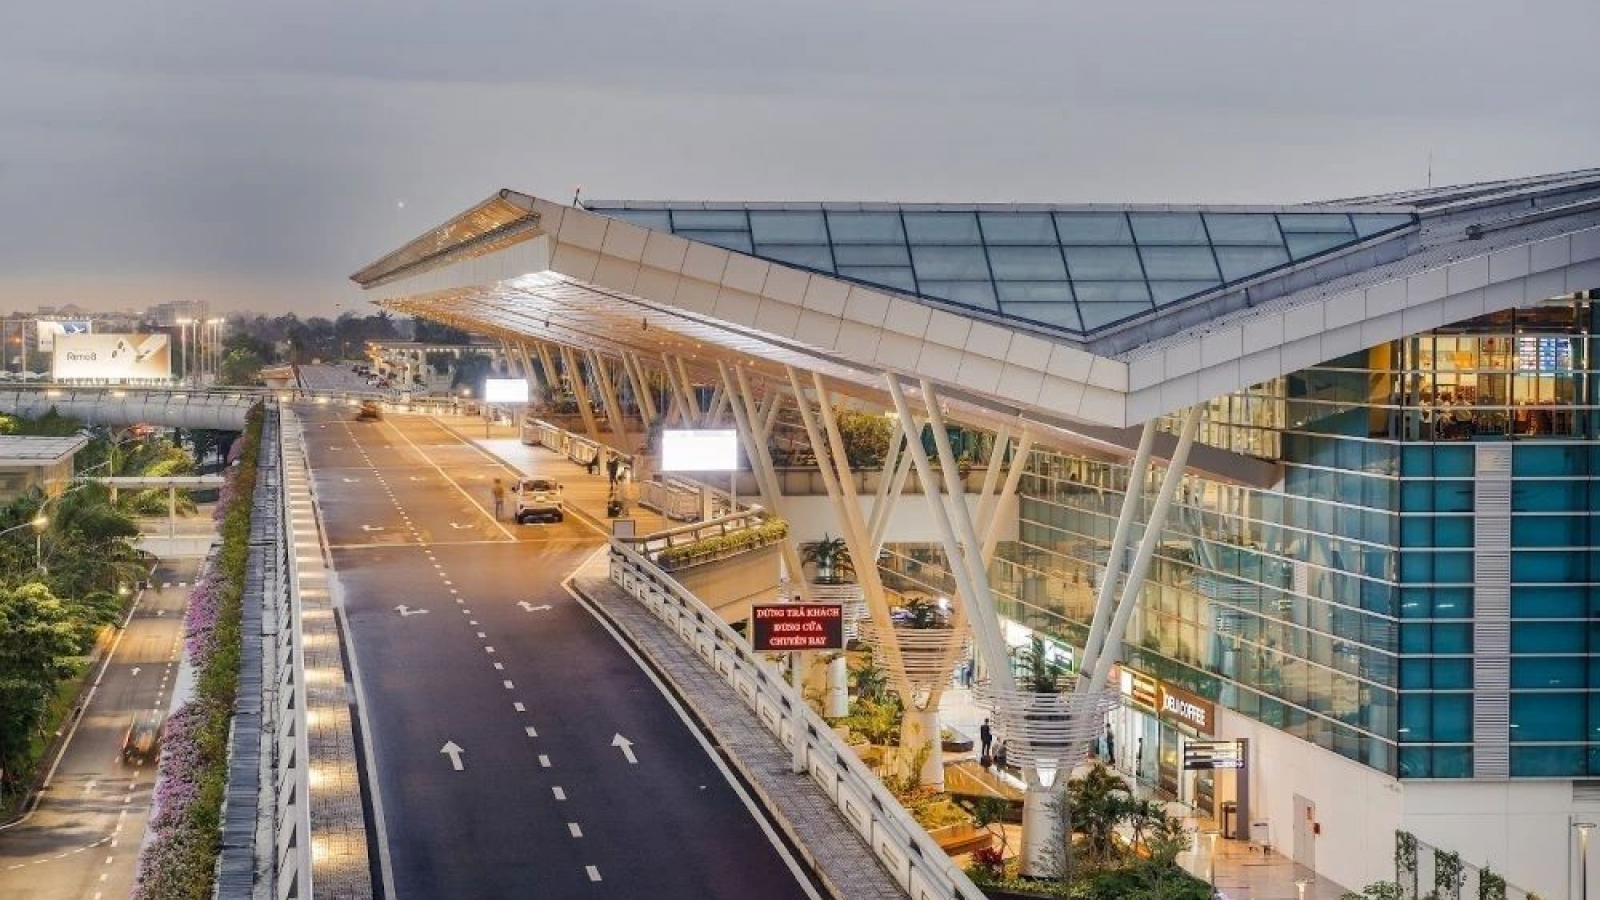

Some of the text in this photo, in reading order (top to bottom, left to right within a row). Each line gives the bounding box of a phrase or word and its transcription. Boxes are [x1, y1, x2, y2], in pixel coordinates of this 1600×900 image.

[66, 351, 97, 361] Reno8
[785, 606, 805, 617] TRẢ
[806, 607, 840, 617] KHÁCH
[802, 620, 823, 632] CỬA
[807, 636, 827, 646] BAY
[1180, 700, 1206, 726] COFFEE
